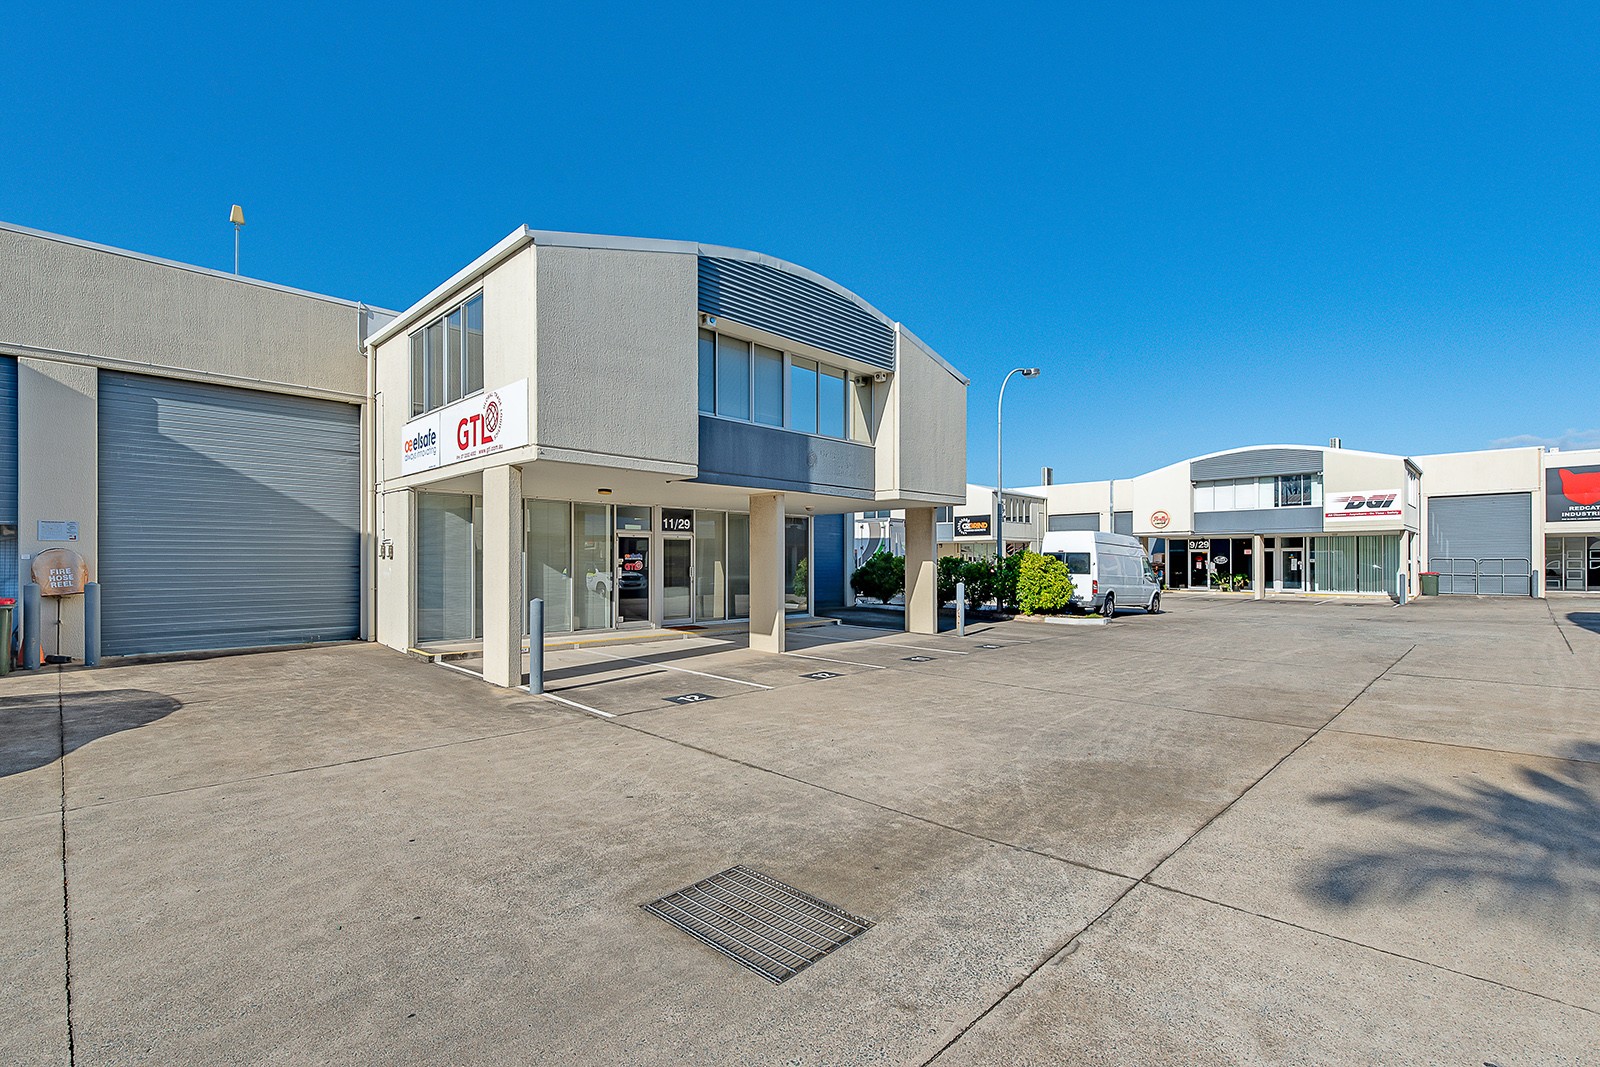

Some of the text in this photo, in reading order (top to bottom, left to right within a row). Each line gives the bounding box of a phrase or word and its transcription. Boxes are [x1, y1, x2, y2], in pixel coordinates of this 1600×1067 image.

[457, 413, 493, 450] GTL
[1343, 493, 1397, 510] DGI
[663, 518, 691, 530] 11/29
[1189, 540, 1210, 549] 9/29
[51, 580, 73, 588] REEL
[676, 694, 707, 702] 12
